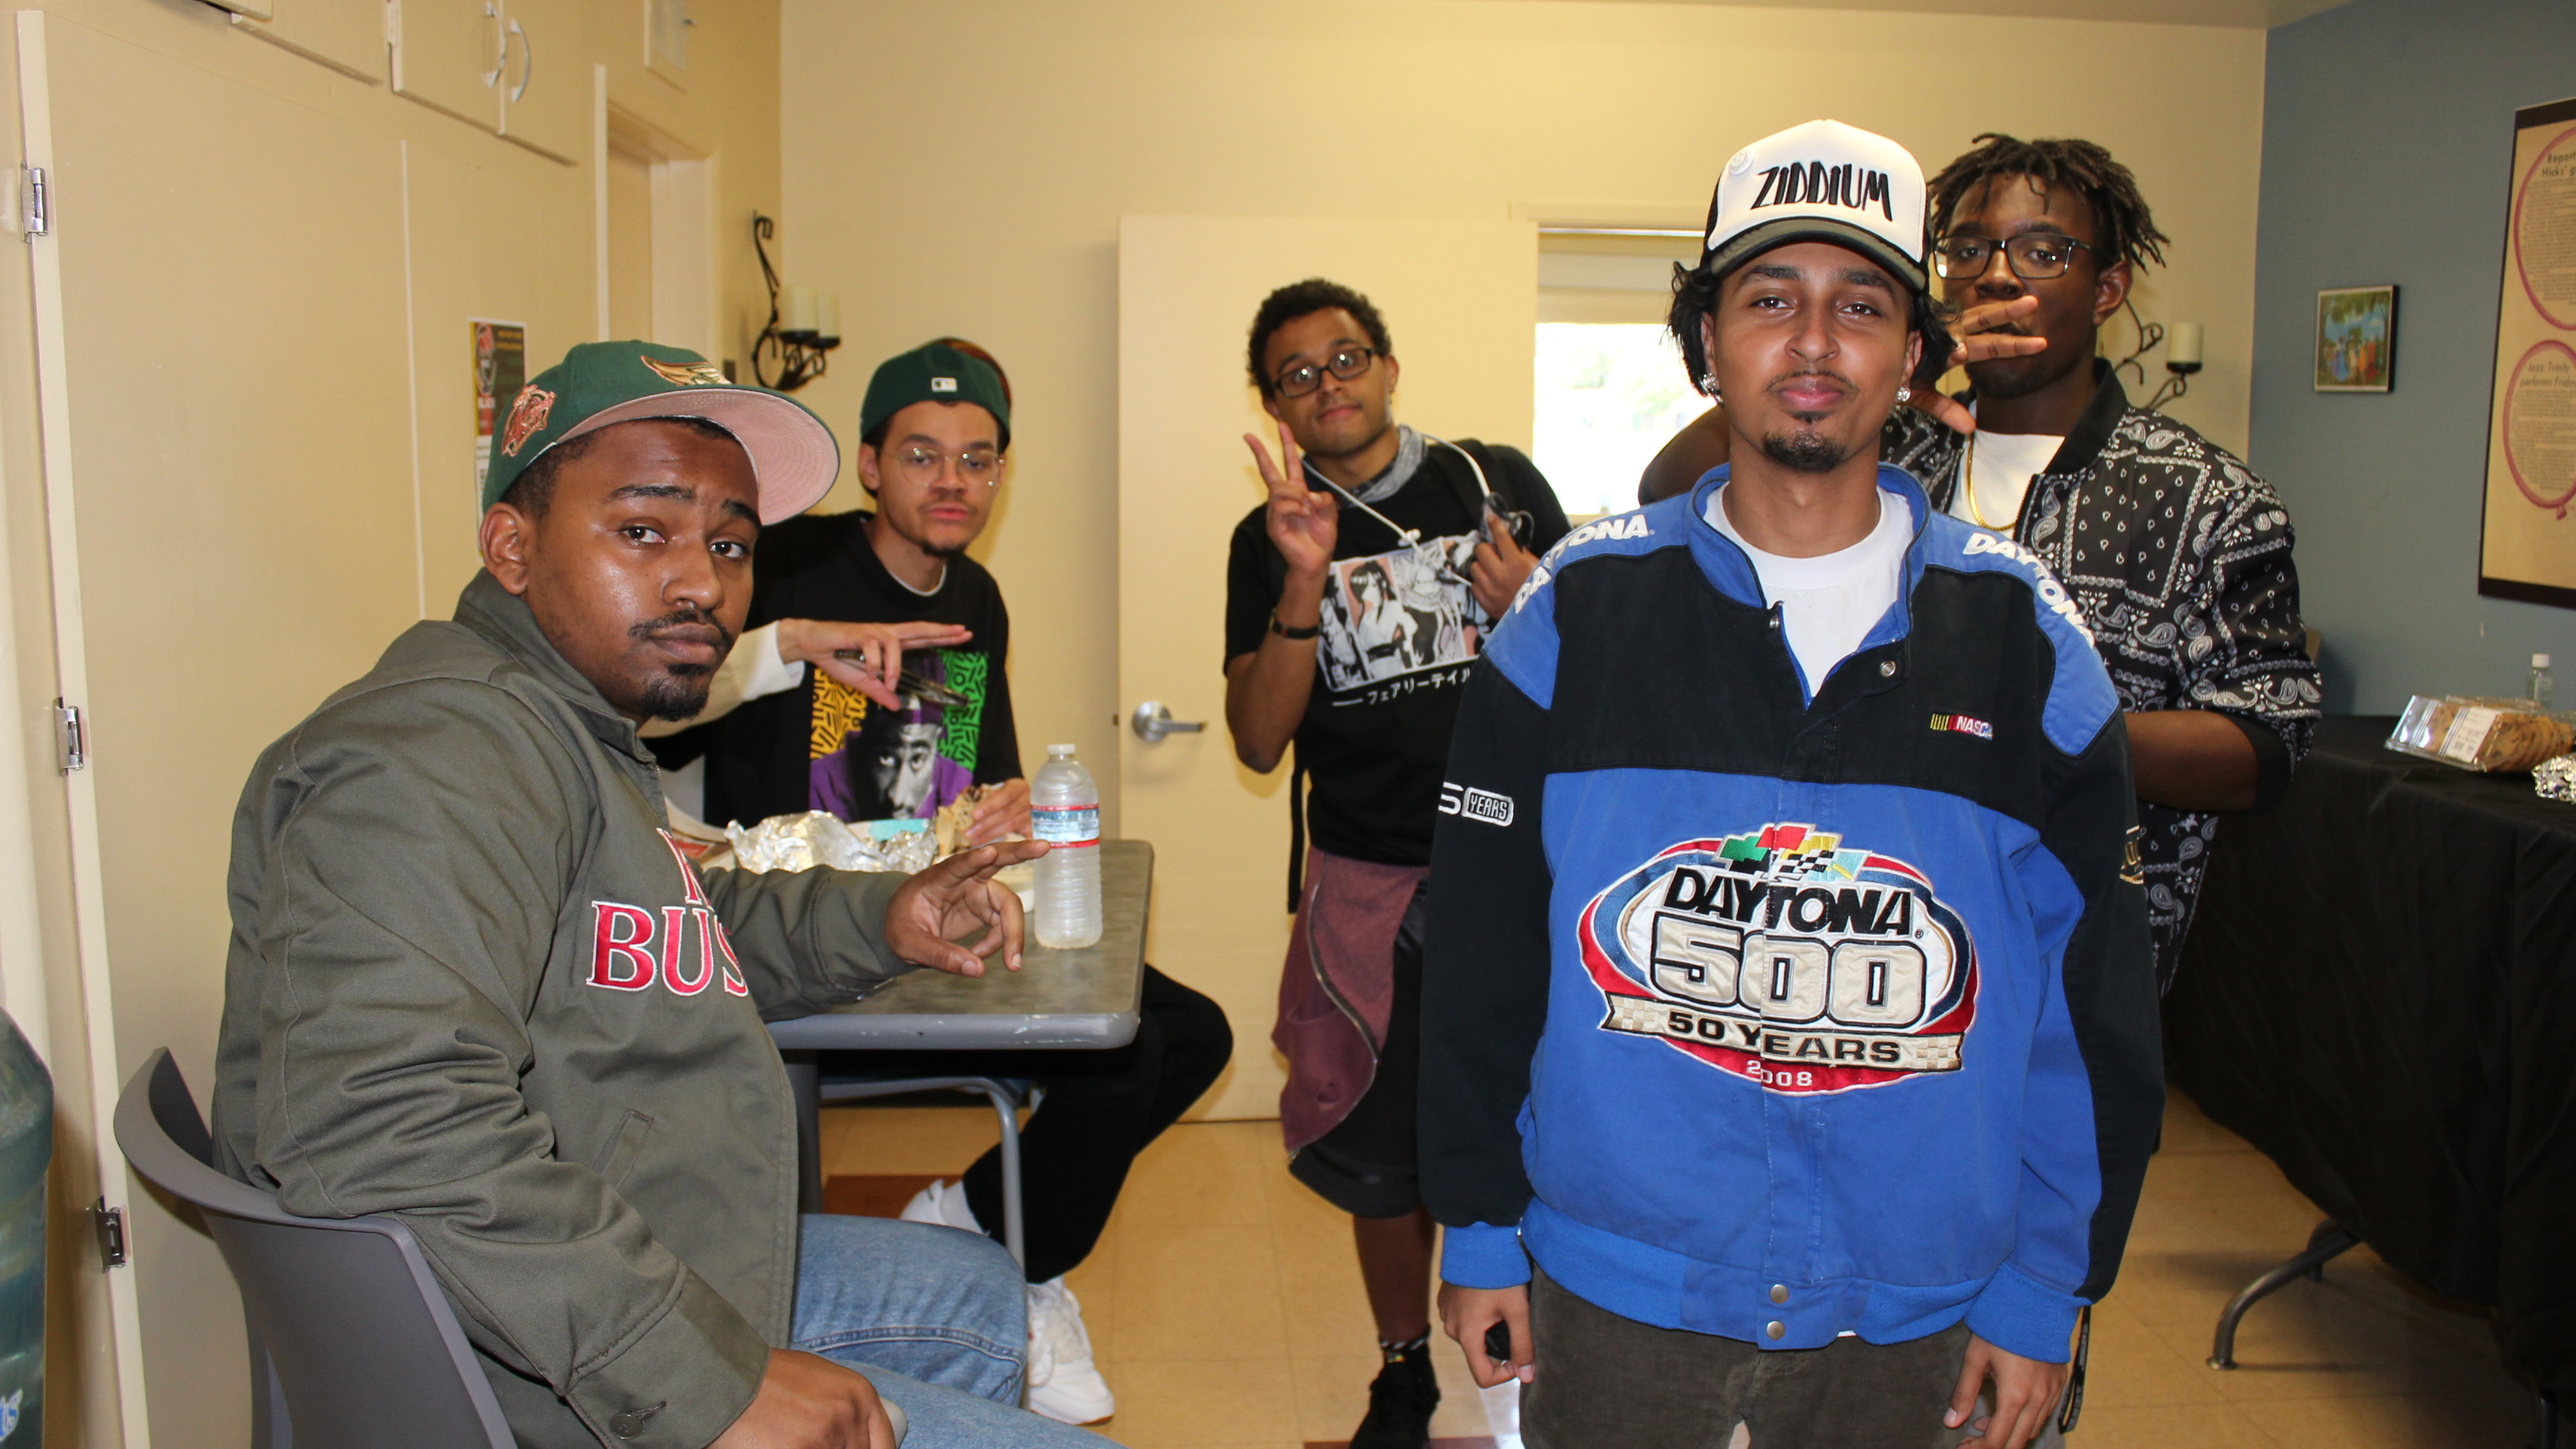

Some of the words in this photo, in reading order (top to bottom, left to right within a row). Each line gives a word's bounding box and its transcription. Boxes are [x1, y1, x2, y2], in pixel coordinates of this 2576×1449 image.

[1750, 161, 1893, 222] ZIDDIUM
[1468, 794, 1508, 820] YEARS
[1664, 866, 1913, 935] DAYTONA
[1650, 911, 1927, 1029] 500
[1667, 1010, 1726, 1041] 50
[1737, 1023, 1901, 1064] YEARS
